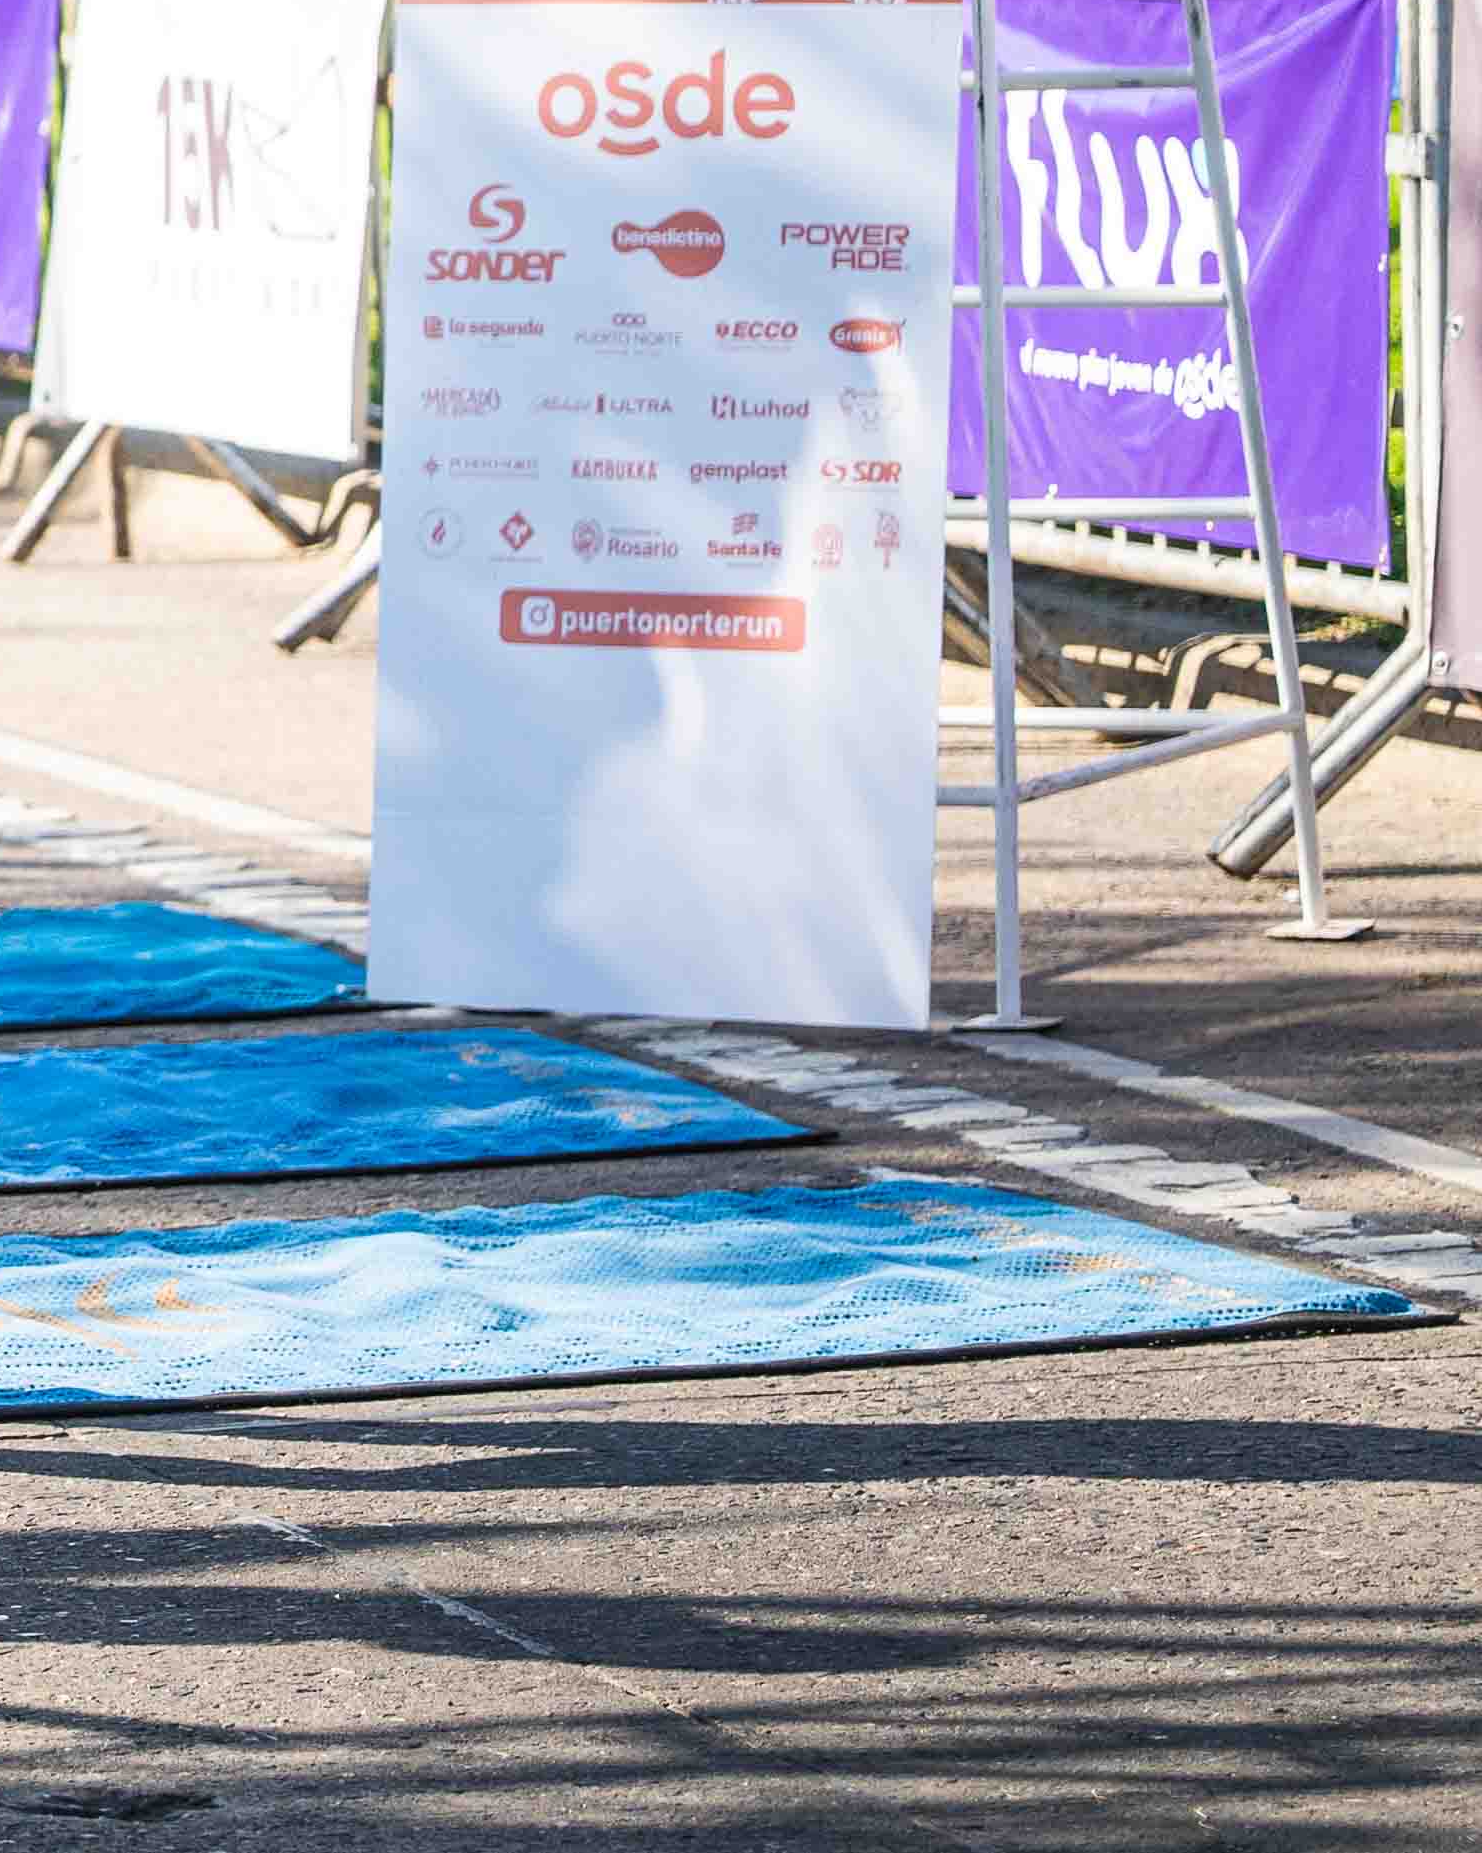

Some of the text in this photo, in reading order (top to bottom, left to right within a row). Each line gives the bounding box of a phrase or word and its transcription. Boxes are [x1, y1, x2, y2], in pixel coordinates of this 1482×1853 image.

[537, 49, 797, 146] osde
[780, 223, 910, 247] POWER
[469, 317, 545, 338] segunda
[731, 321, 799, 339] ECCO
[690, 460, 788, 484] gemplast
[607, 537, 679, 558] Rosario
[707, 540, 783, 558] Santa Fe
[560, 607, 784, 639] puertonorterun
